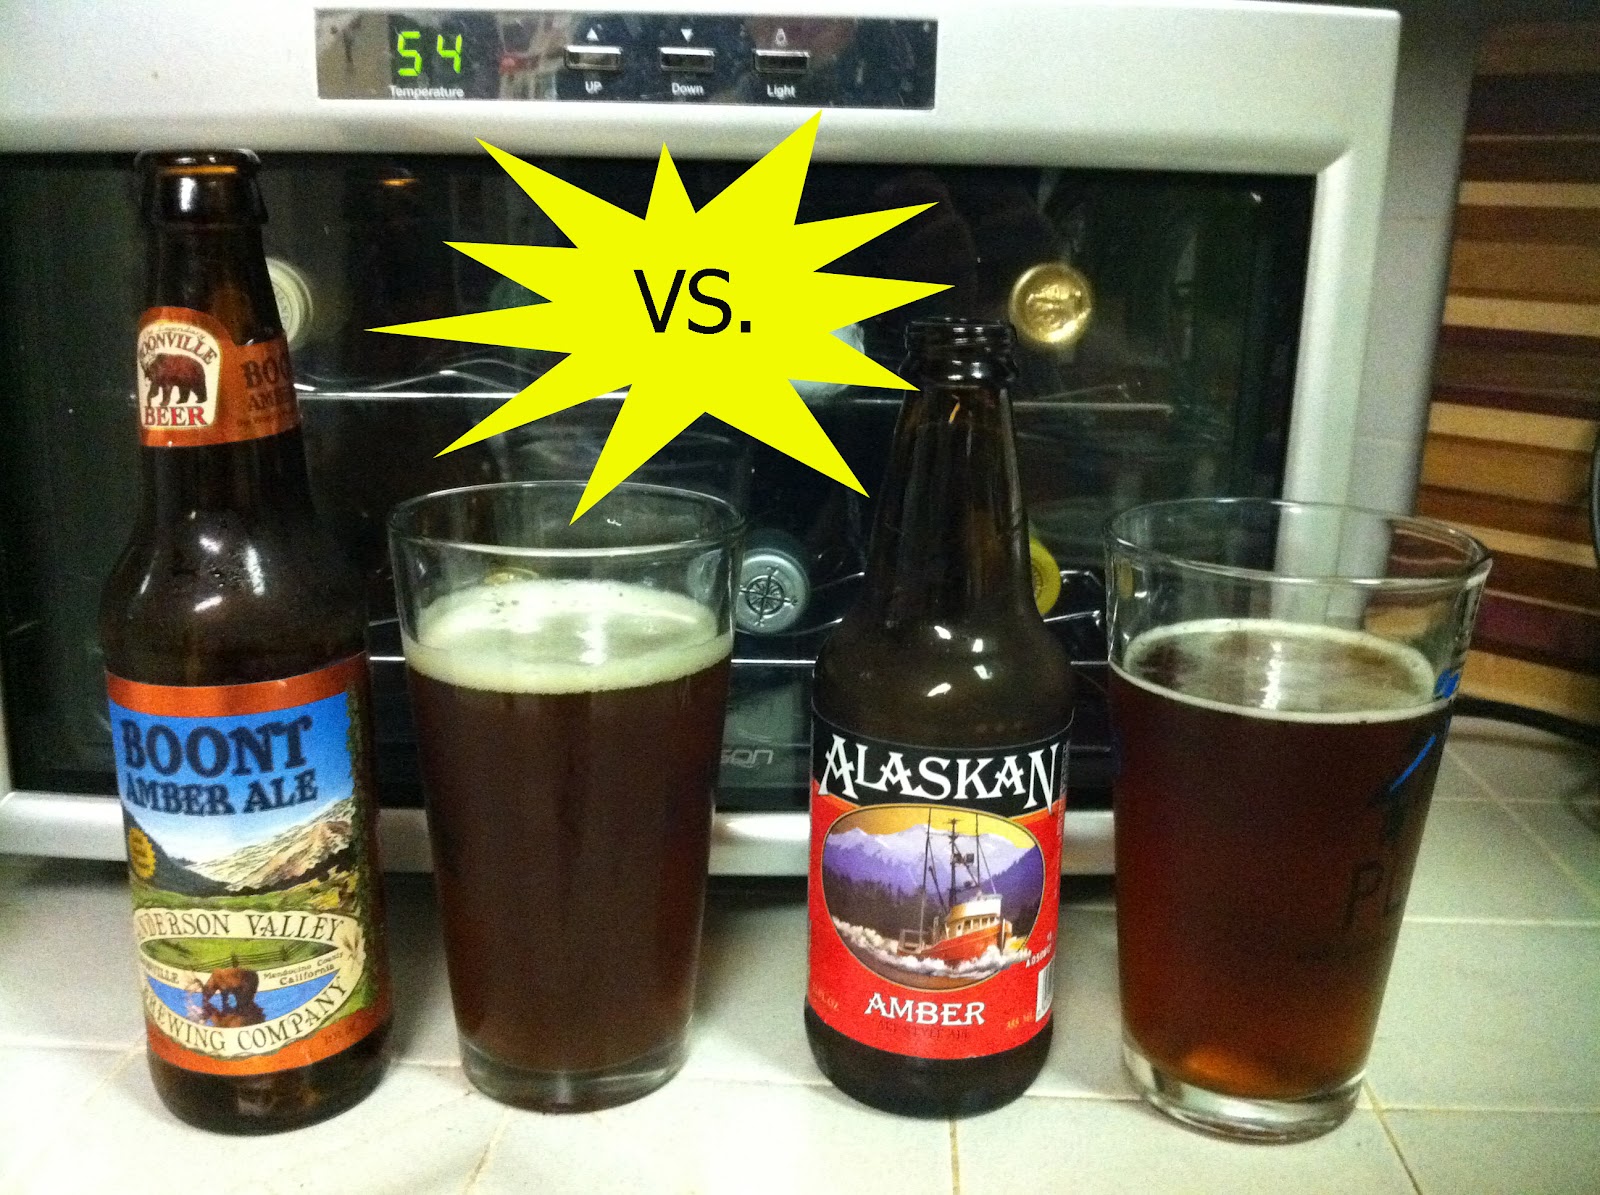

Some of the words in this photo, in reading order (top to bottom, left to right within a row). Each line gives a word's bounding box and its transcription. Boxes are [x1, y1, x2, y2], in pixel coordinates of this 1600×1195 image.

[397, 31, 462, 77] 54
[388, 85, 465, 99] Temperature
[584, 81, 603, 94] UP
[671, 82, 704, 96] Down
[766, 84, 796, 100] Light
[144, 405, 208, 427] BEER
[120, 716, 313, 778] BOONT
[817, 733, 1060, 815] ALASKAN
[126, 772, 236, 817] AMBER
[243, 768, 319, 813] ALE
[136, 911, 231, 940] NDERSON
[245, 914, 344, 942] VALLEY
[263, 964, 312, 980] Mendocino
[279, 963, 335, 986] California
[146, 990, 226, 1051] REWING
[237, 975, 347, 1051] COMPANY
[864, 992, 985, 1026] AMBER
